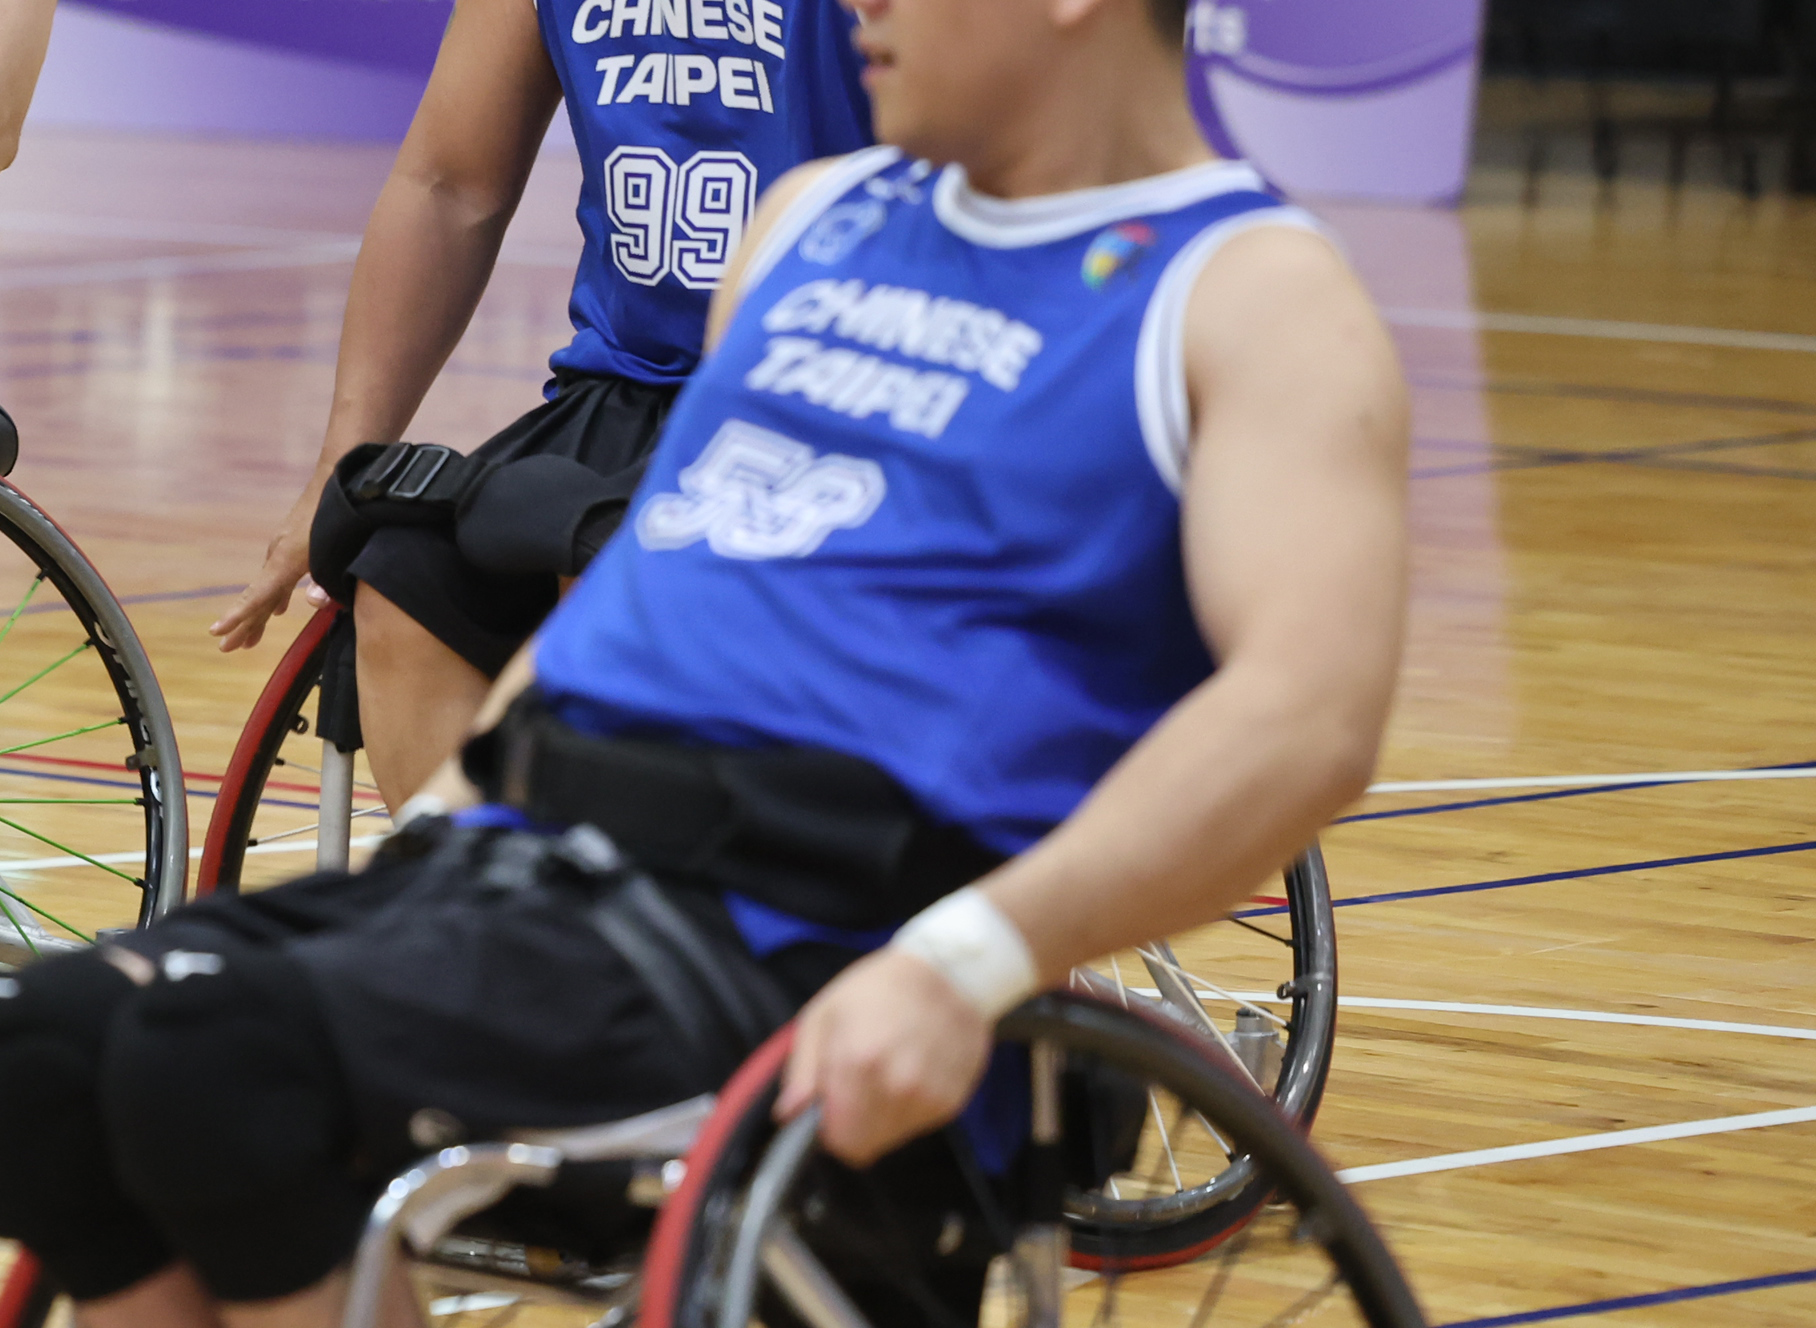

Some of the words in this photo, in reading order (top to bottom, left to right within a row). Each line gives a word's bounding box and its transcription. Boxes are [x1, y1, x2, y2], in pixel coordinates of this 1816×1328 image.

[595, 52, 774, 114] TAIPEI
[604, 145, 758, 290] 99
[744, 335, 970, 440] TAIPEI
[761, 278, 1043, 393] CHINESE
